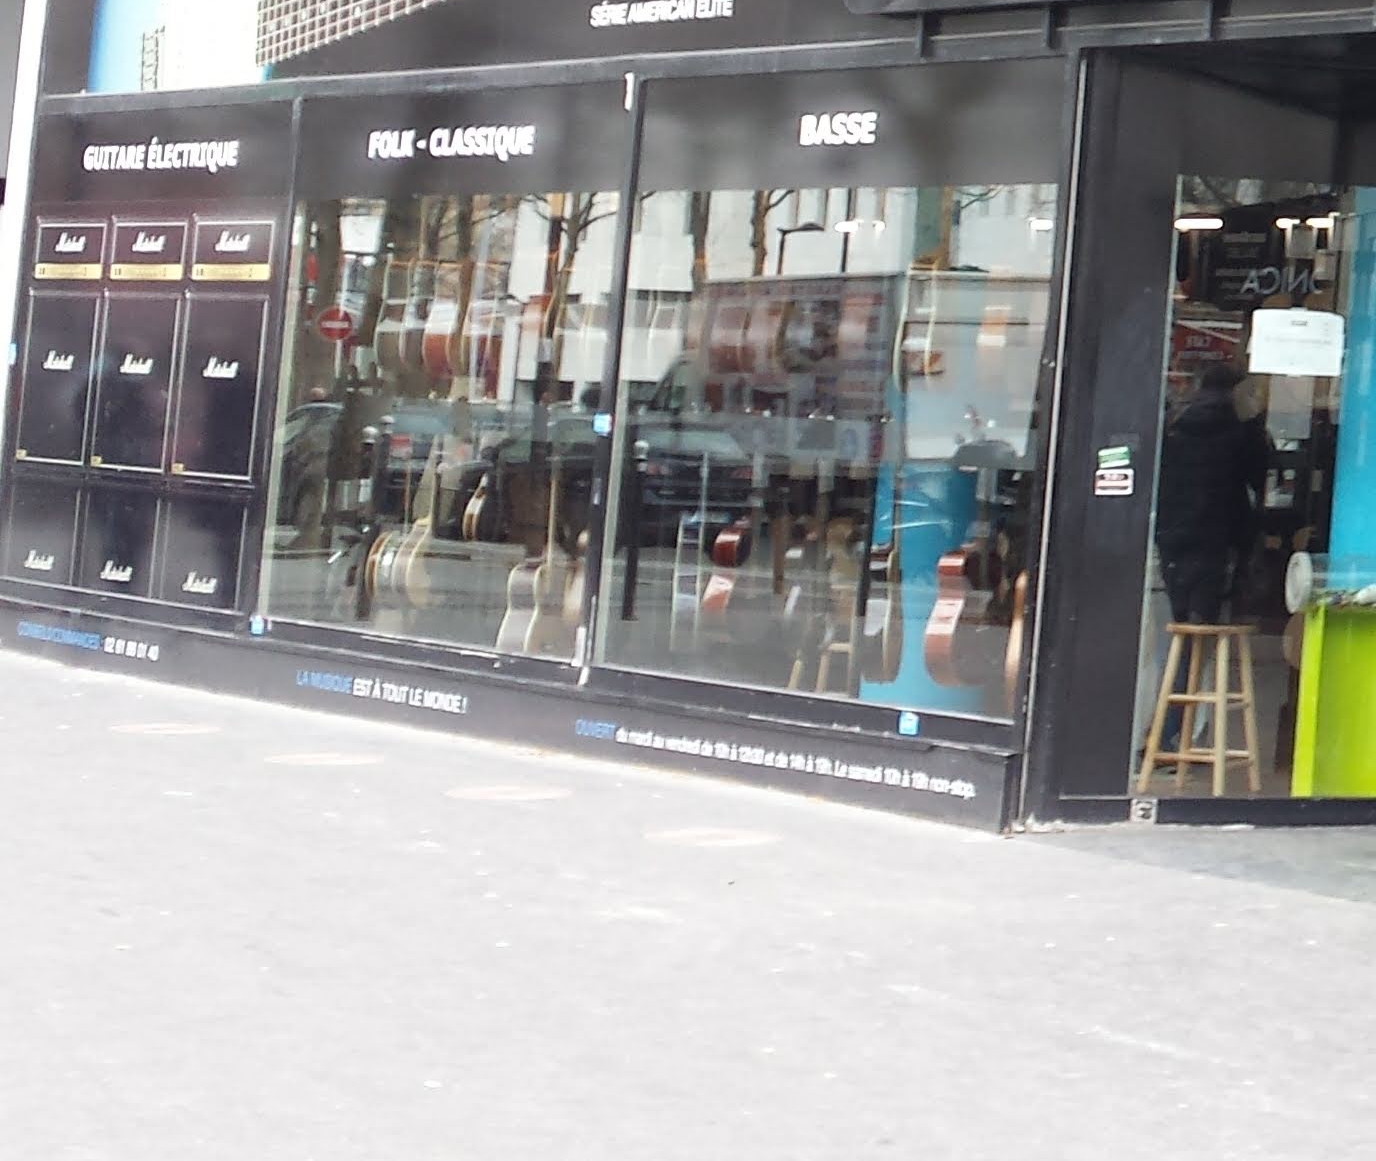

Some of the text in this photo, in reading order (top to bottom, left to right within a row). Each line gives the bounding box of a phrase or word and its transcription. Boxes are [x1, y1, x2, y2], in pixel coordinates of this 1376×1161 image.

[367, 127, 417, 159] FOLK
[428, 124, 537, 162] CLASSIQUE
[799, 110, 879, 147] BASSE
[82, 136, 240, 173] GUITARE ÉLECTRIQUE
[352, 677, 373, 697] EST
[382, 682, 409, 704] TOUT
[408, 687, 424, 707] LE
[423, 690, 461, 714] MONDE
